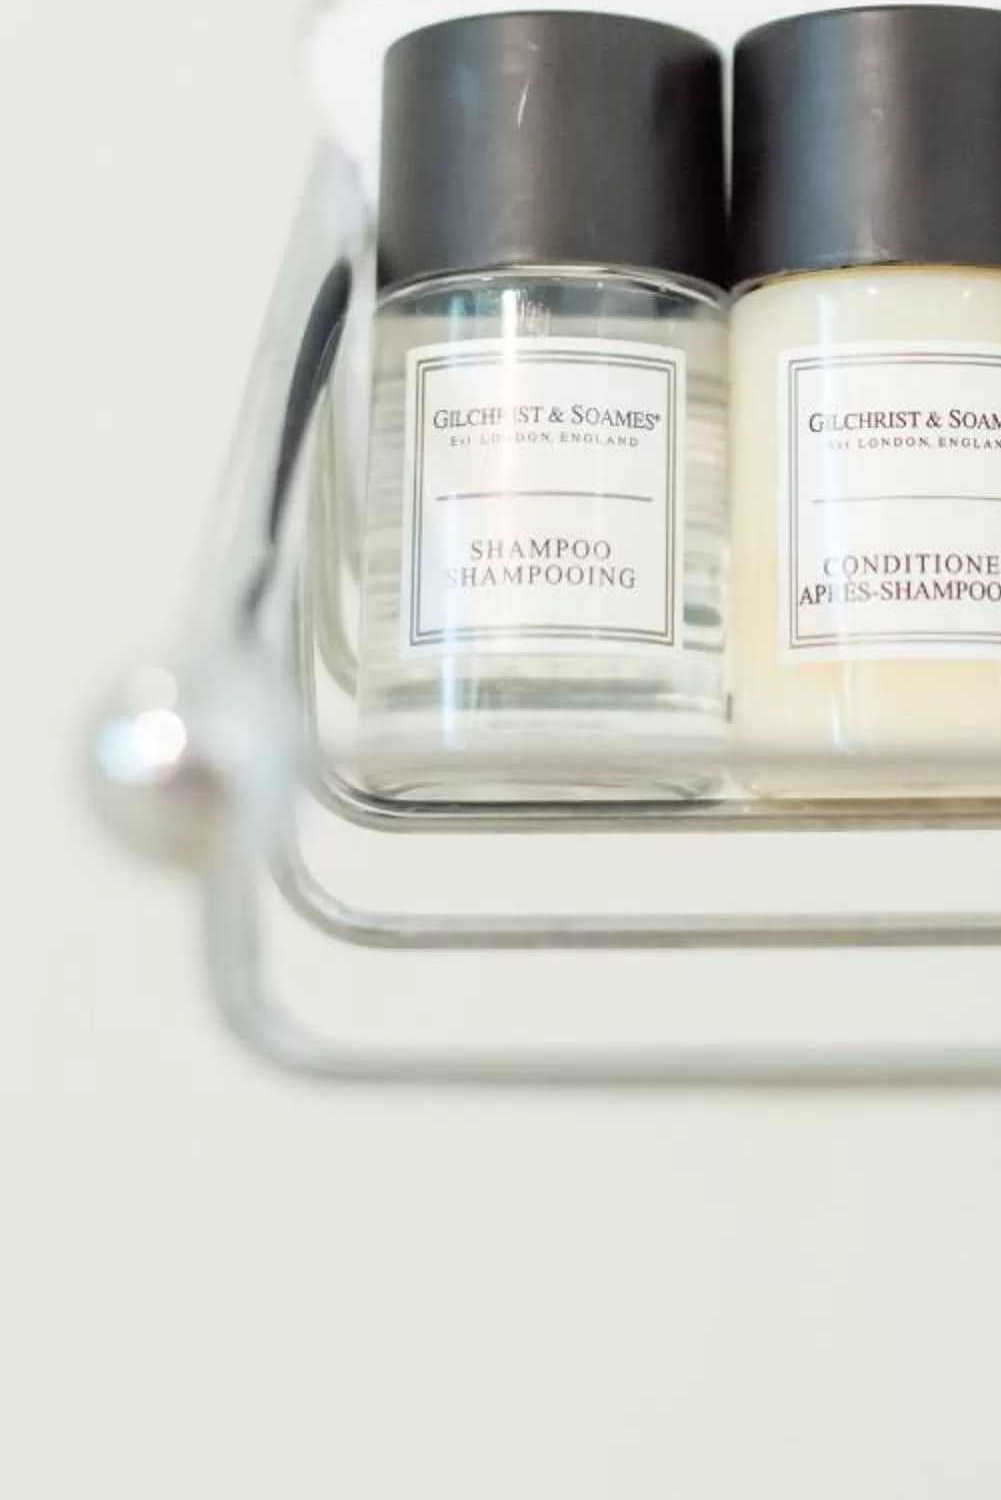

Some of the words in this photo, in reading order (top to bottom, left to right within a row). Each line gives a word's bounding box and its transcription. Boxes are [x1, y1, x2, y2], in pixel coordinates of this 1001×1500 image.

[547, 404, 565, 424] &
[809, 411, 922, 433] GLCHRIST
[925, 411, 942, 429] &
[559, 431, 639, 448] ENGLAND
[470, 538, 612, 561] SHAMPOO
[444, 563, 636, 589] SHAMPOOING
